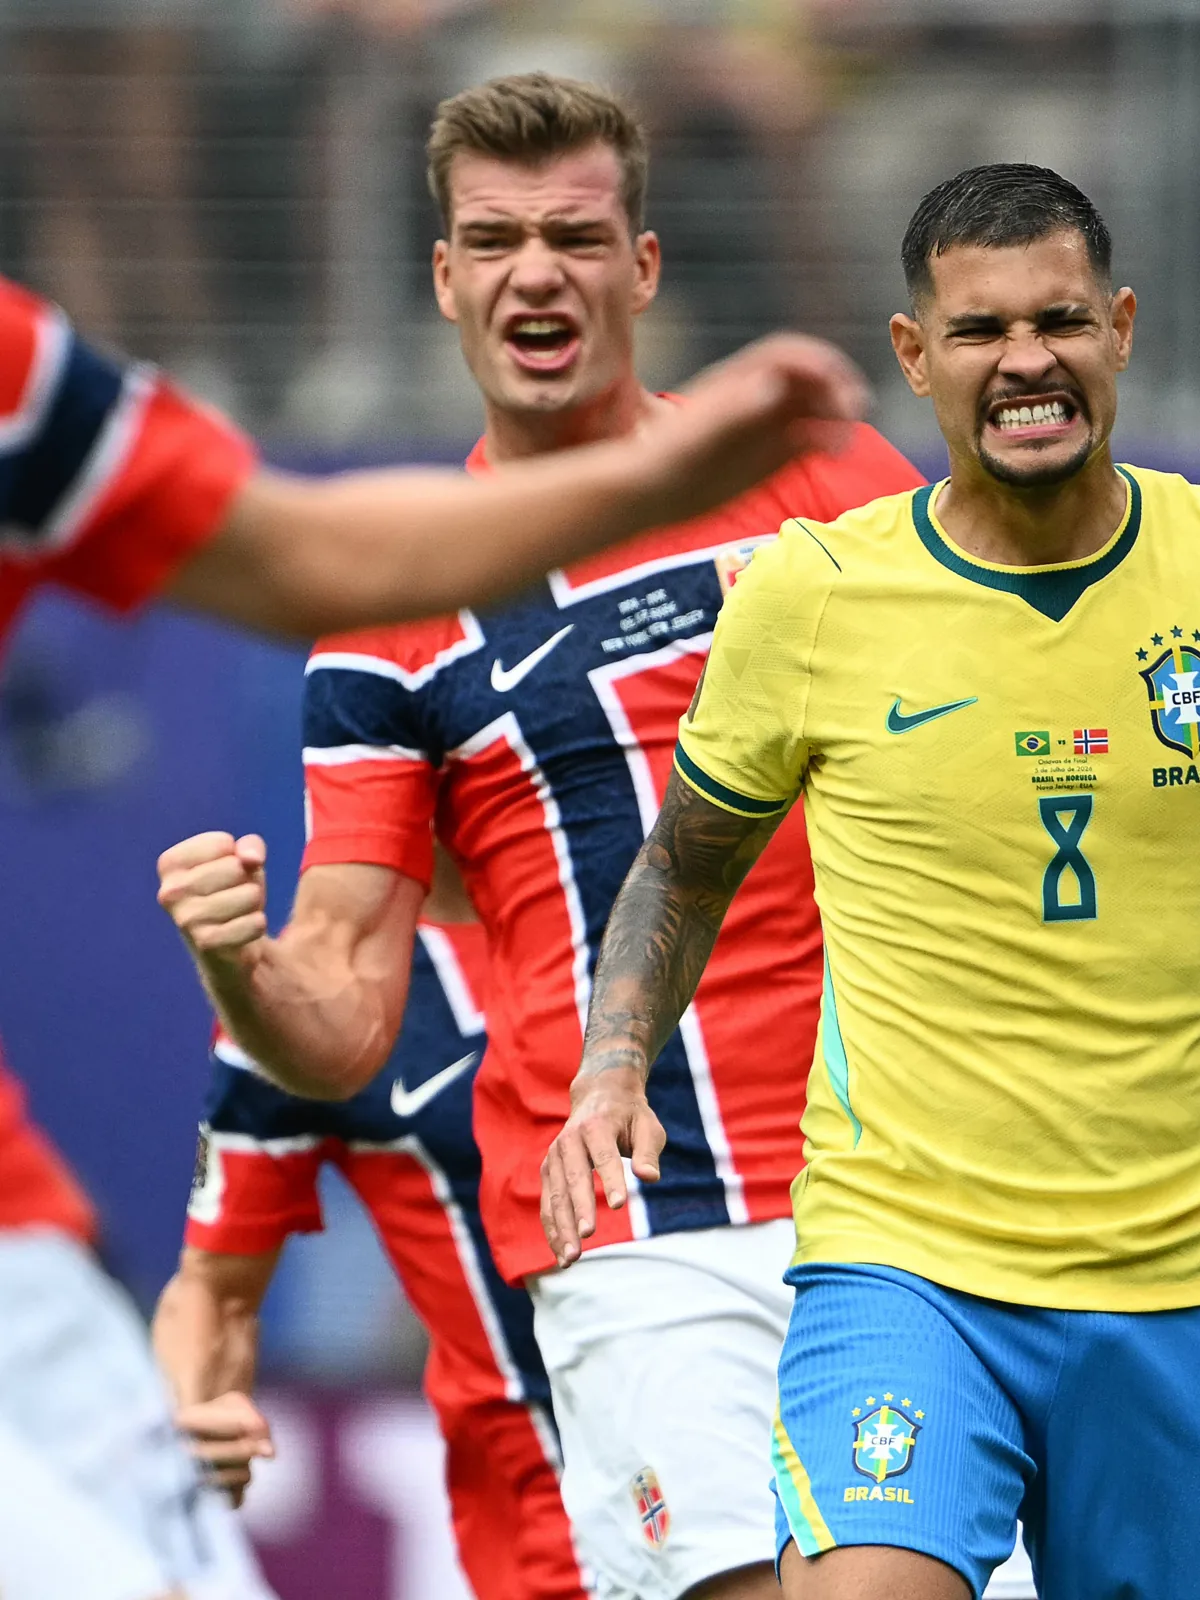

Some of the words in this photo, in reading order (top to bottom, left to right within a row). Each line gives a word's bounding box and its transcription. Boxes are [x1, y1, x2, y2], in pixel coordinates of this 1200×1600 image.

[1172, 690, 1200, 705] CBF
[1065, 774, 1097, 782] NORUEGA
[1037, 793, 1098, 924] 8
[871, 1436, 896, 1446] CBF
[843, 1486, 915, 1504] BRASIL
